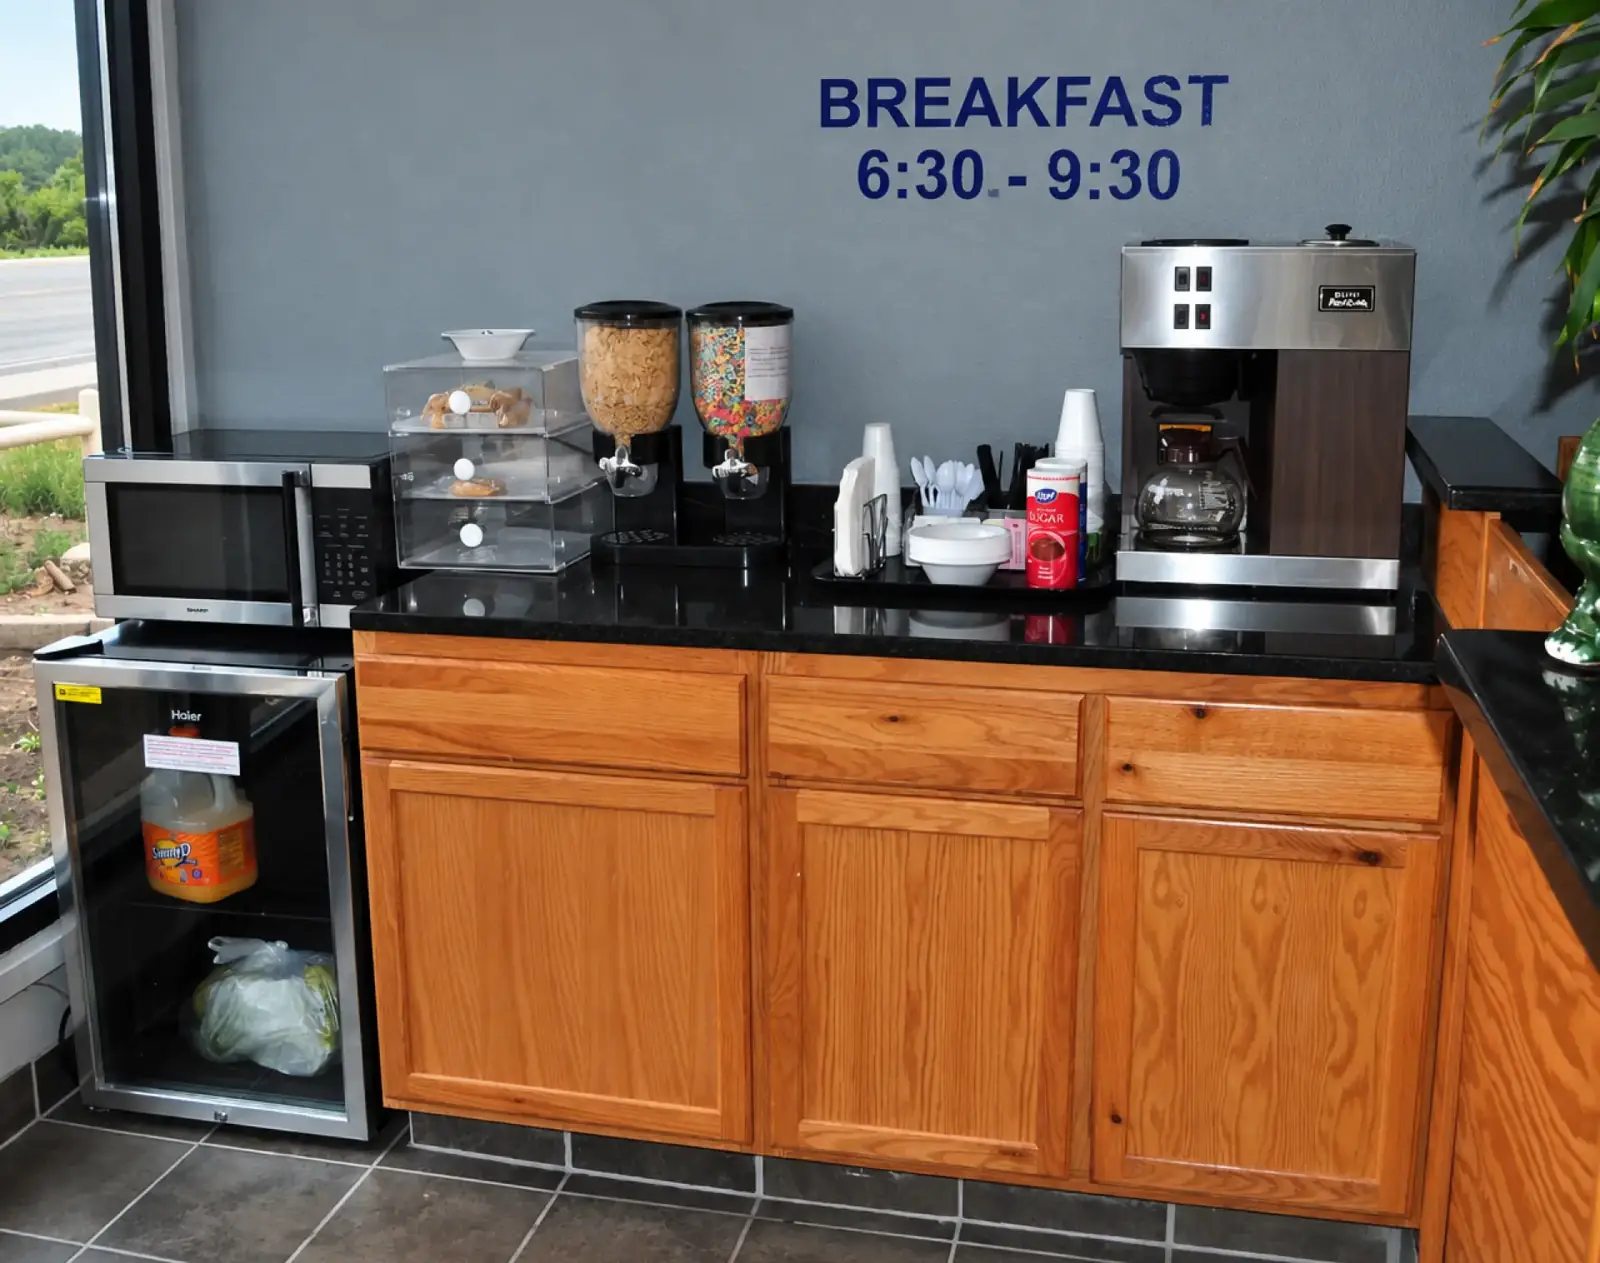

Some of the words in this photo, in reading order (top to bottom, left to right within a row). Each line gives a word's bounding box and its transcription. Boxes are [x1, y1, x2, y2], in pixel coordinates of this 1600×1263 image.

[820, 75, 1229, 127] BREAKFAST
[857, 149, 984, 200] 6:30
[1008, 176, 1027, 187] -
[1047, 149, 1181, 200] 9:30
[171, 709, 202, 721] Haier
